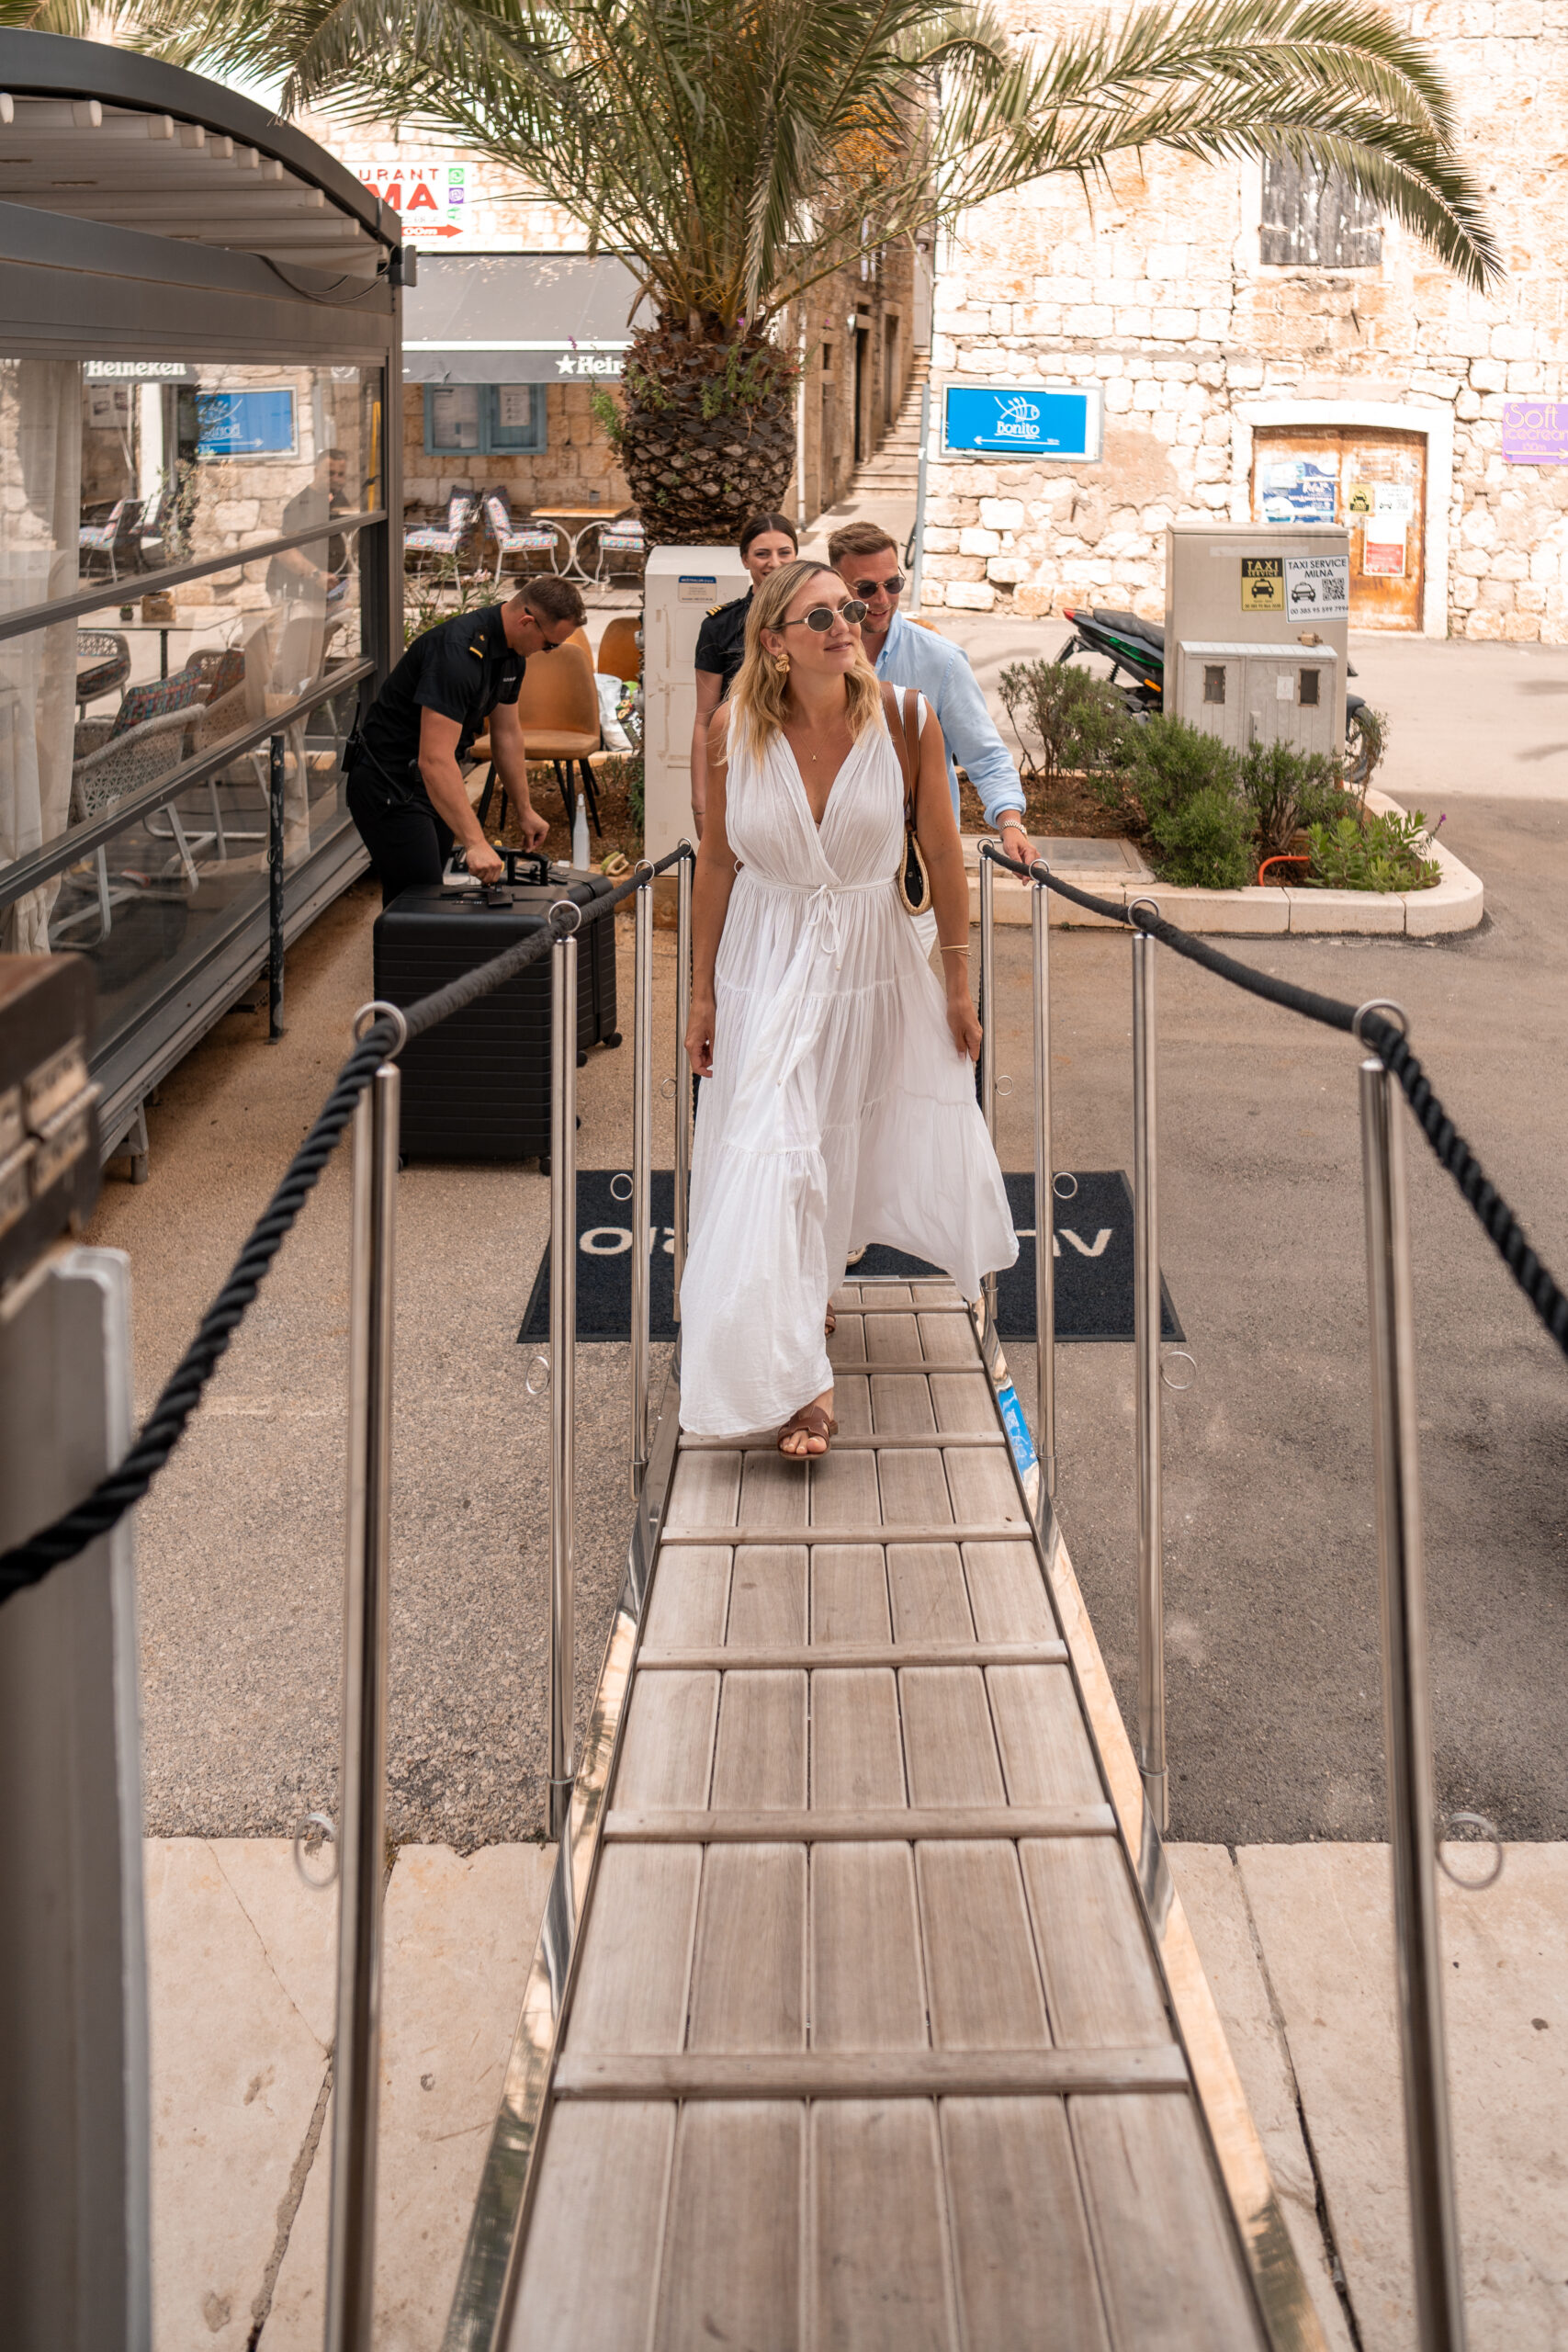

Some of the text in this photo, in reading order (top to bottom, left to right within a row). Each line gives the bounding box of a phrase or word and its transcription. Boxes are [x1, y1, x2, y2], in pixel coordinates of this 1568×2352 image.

[1505, 403, 1559, 430] Soft
[997, 421, 1041, 436] Bonito
[1247, 560, 1279, 570] TAXI
[1288, 559, 1347, 570] TAXI SERVICE
[1304, 569, 1334, 578] MILNA
